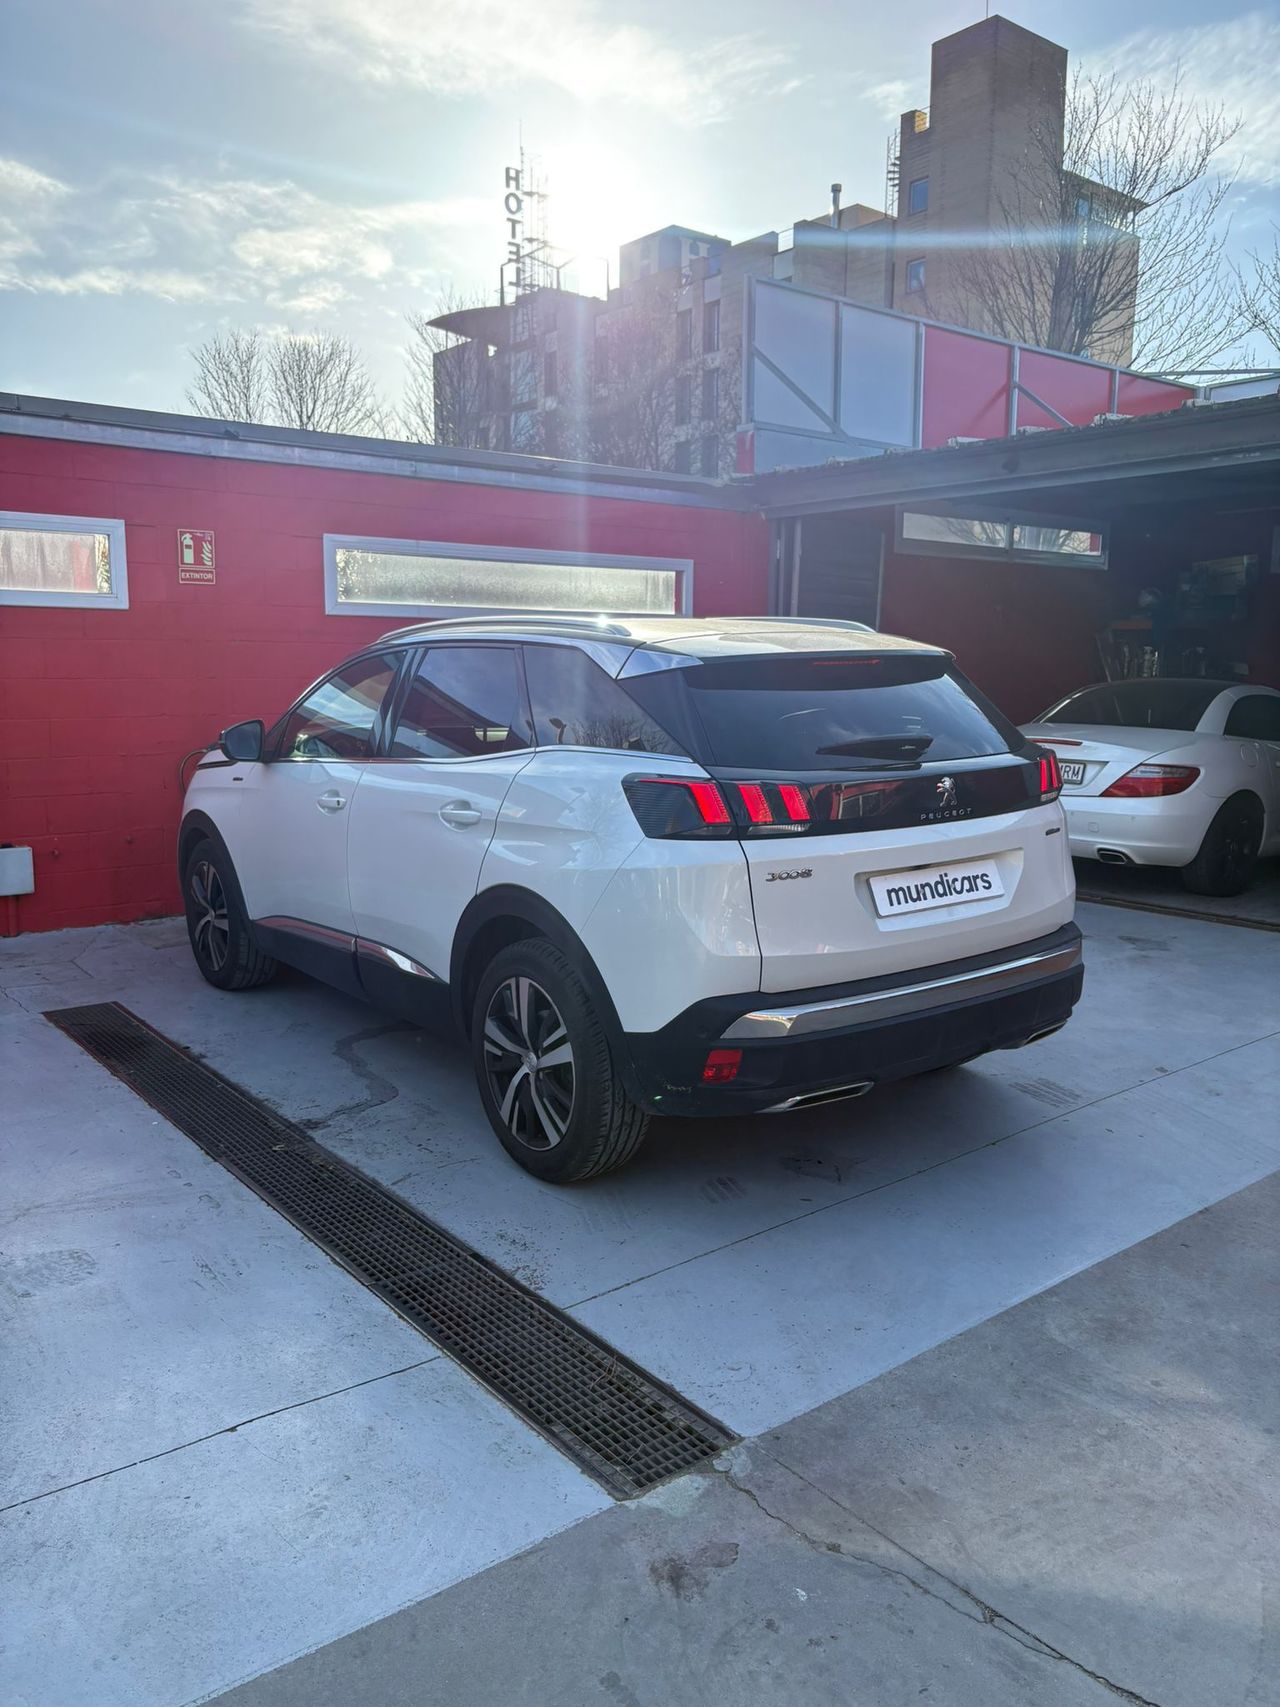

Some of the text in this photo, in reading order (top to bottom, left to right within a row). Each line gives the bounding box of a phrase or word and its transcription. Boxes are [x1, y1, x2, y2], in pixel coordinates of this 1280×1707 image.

[181, 572, 213, 580] EXTINTOR
[920, 808, 972, 820] PEUGEOT
[765, 868, 813, 882] 3008
[886, 872, 993, 907] mundicars
